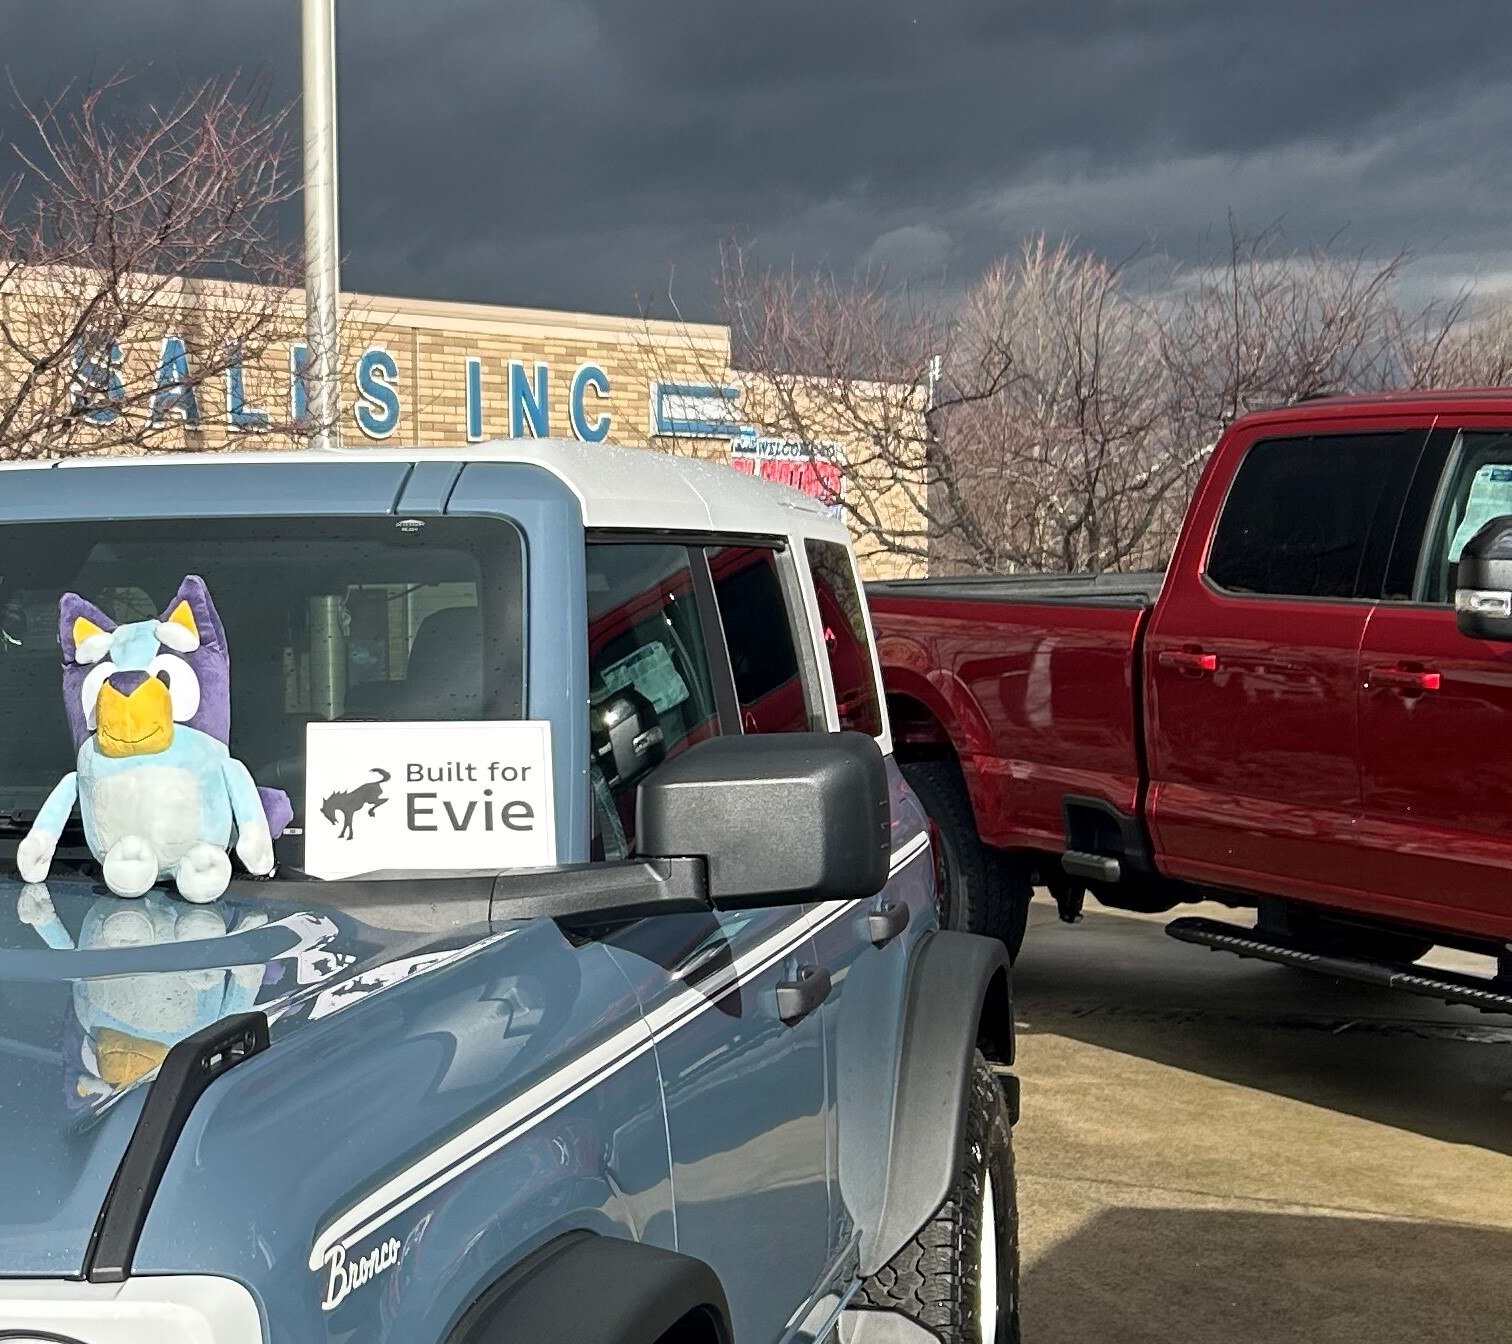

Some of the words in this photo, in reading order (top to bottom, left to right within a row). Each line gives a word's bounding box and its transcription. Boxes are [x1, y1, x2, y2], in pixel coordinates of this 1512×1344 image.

[466, 357, 611, 443] INC
[406, 761, 477, 782] Built
[488, 761, 531, 782] for
[406, 788, 534, 831] Evie
[322, 1237, 401, 1311] Bronco
